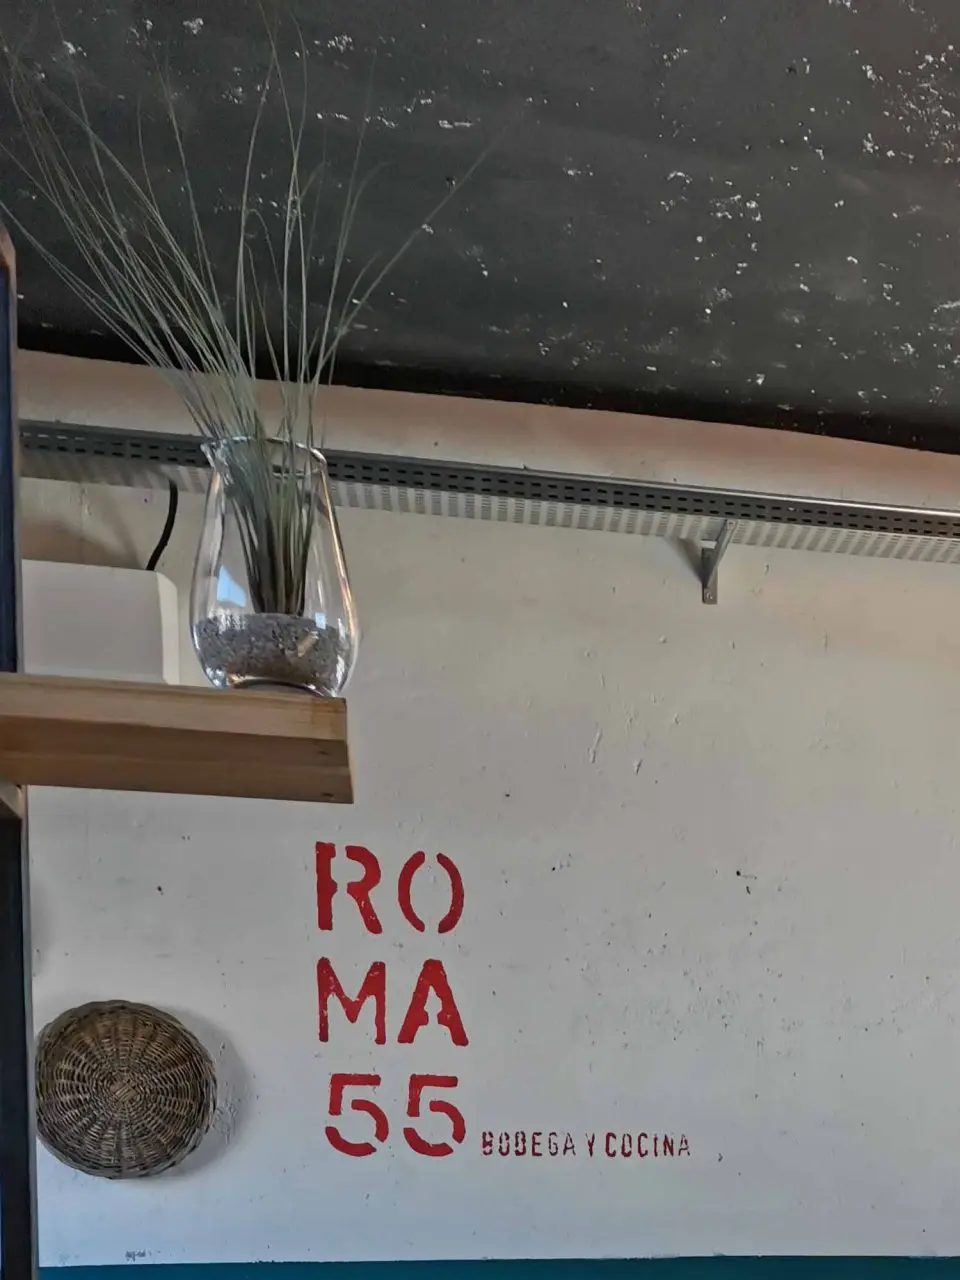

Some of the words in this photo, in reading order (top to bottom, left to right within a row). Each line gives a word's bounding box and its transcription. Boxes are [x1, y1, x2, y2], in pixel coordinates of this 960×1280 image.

[314, 841, 466, 935] RO
[315, 957, 469, 1047] MA
[324, 1073, 467, 1158] 55
[481, 1130, 576, 1157] BODEGA
[585, 1132, 596, 1158] Y
[605, 1131, 691, 1158] COCINA
